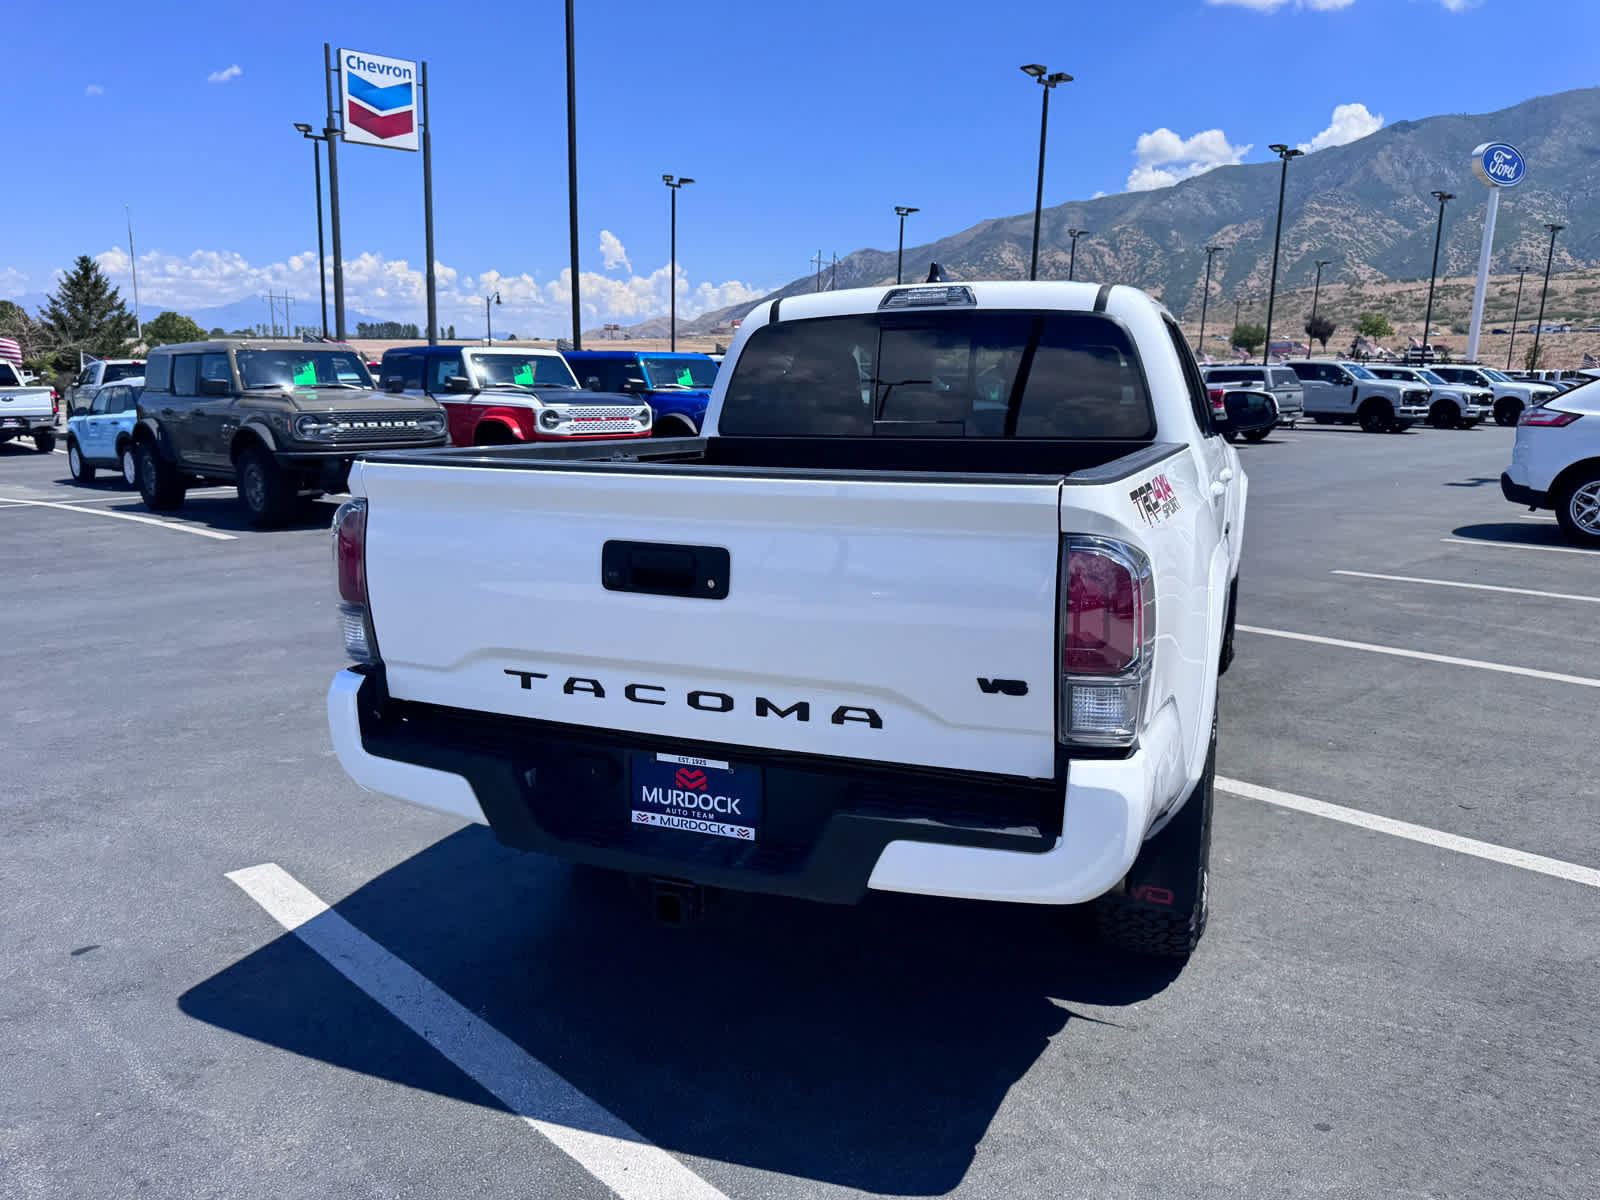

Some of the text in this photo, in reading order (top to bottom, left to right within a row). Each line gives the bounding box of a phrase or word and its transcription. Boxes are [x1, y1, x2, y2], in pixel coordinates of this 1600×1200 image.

[346, 55, 412, 79] Chevron
[1489, 150, 1518, 179] Ford
[504, 669, 883, 729] TACOMA
[642, 785, 742, 815] MURDOCK
[659, 815, 726, 835] MURDOCK
[665, 807, 715, 820] AUTO TEAM
